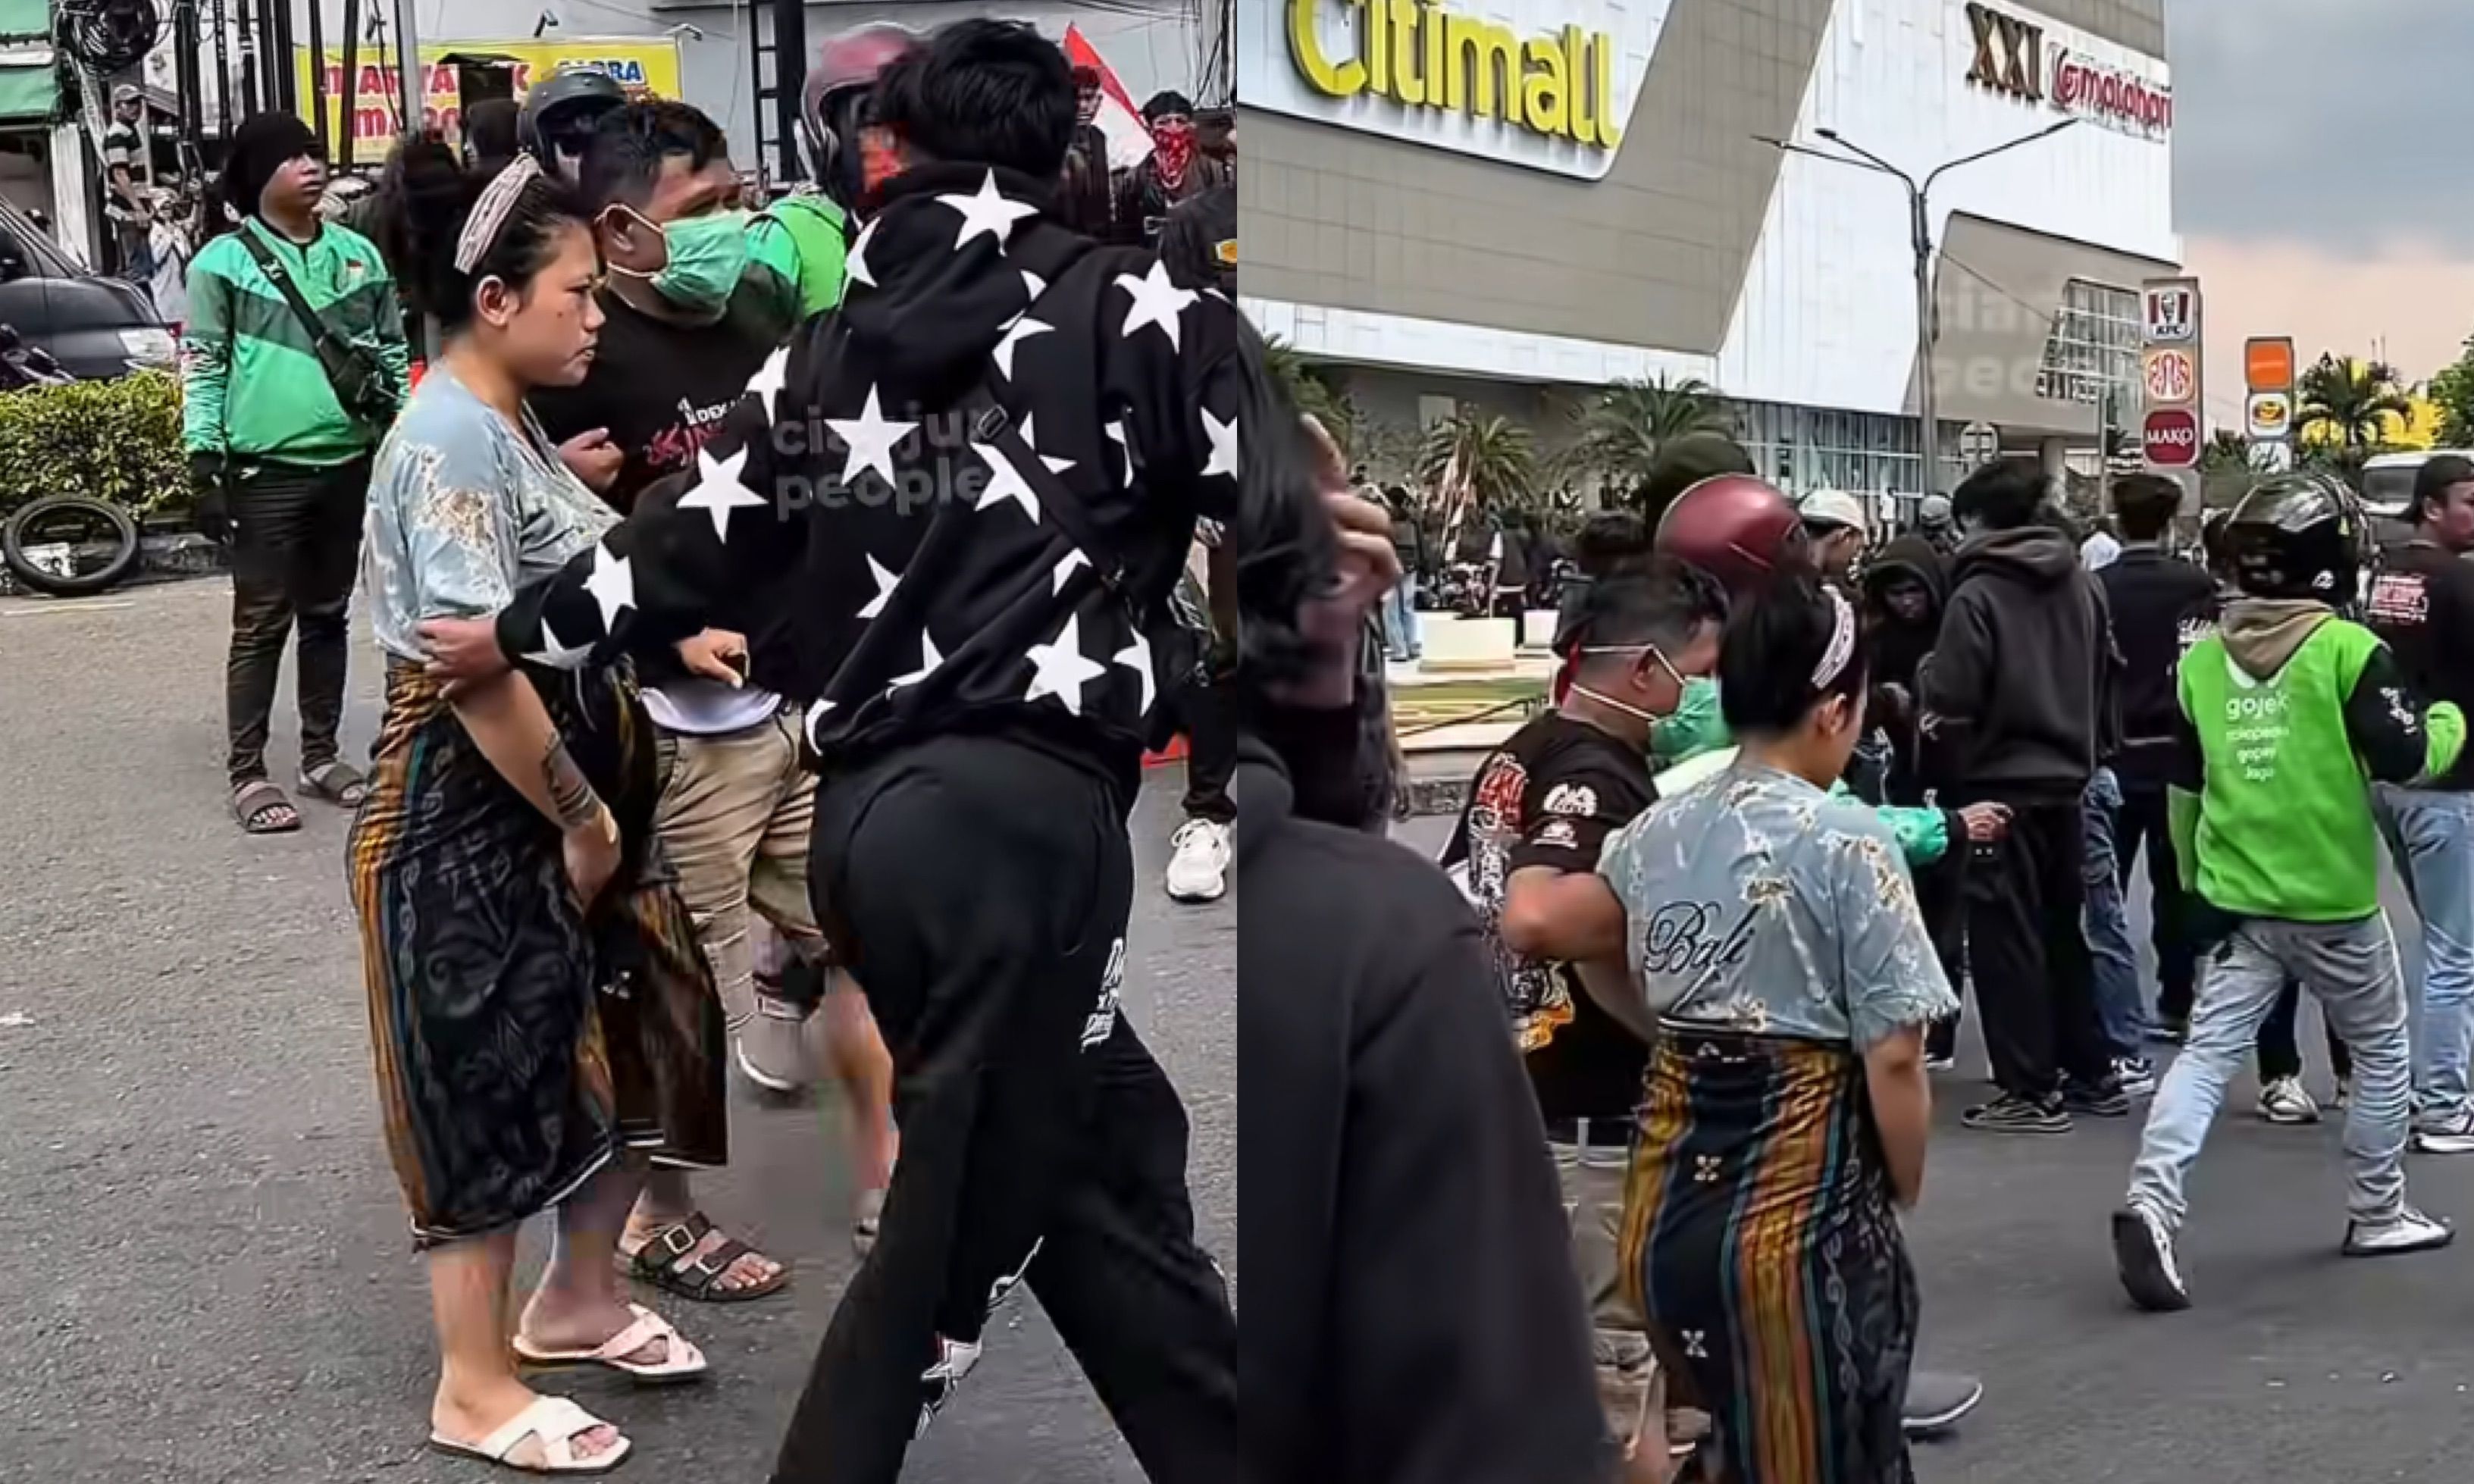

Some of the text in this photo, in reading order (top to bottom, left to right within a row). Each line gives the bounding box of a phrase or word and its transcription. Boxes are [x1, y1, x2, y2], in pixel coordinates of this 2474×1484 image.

[1966, 2, 2044, 100] XXI
[2225, 690, 2289, 720] gojek
[1643, 900, 1761, 974] Bali
